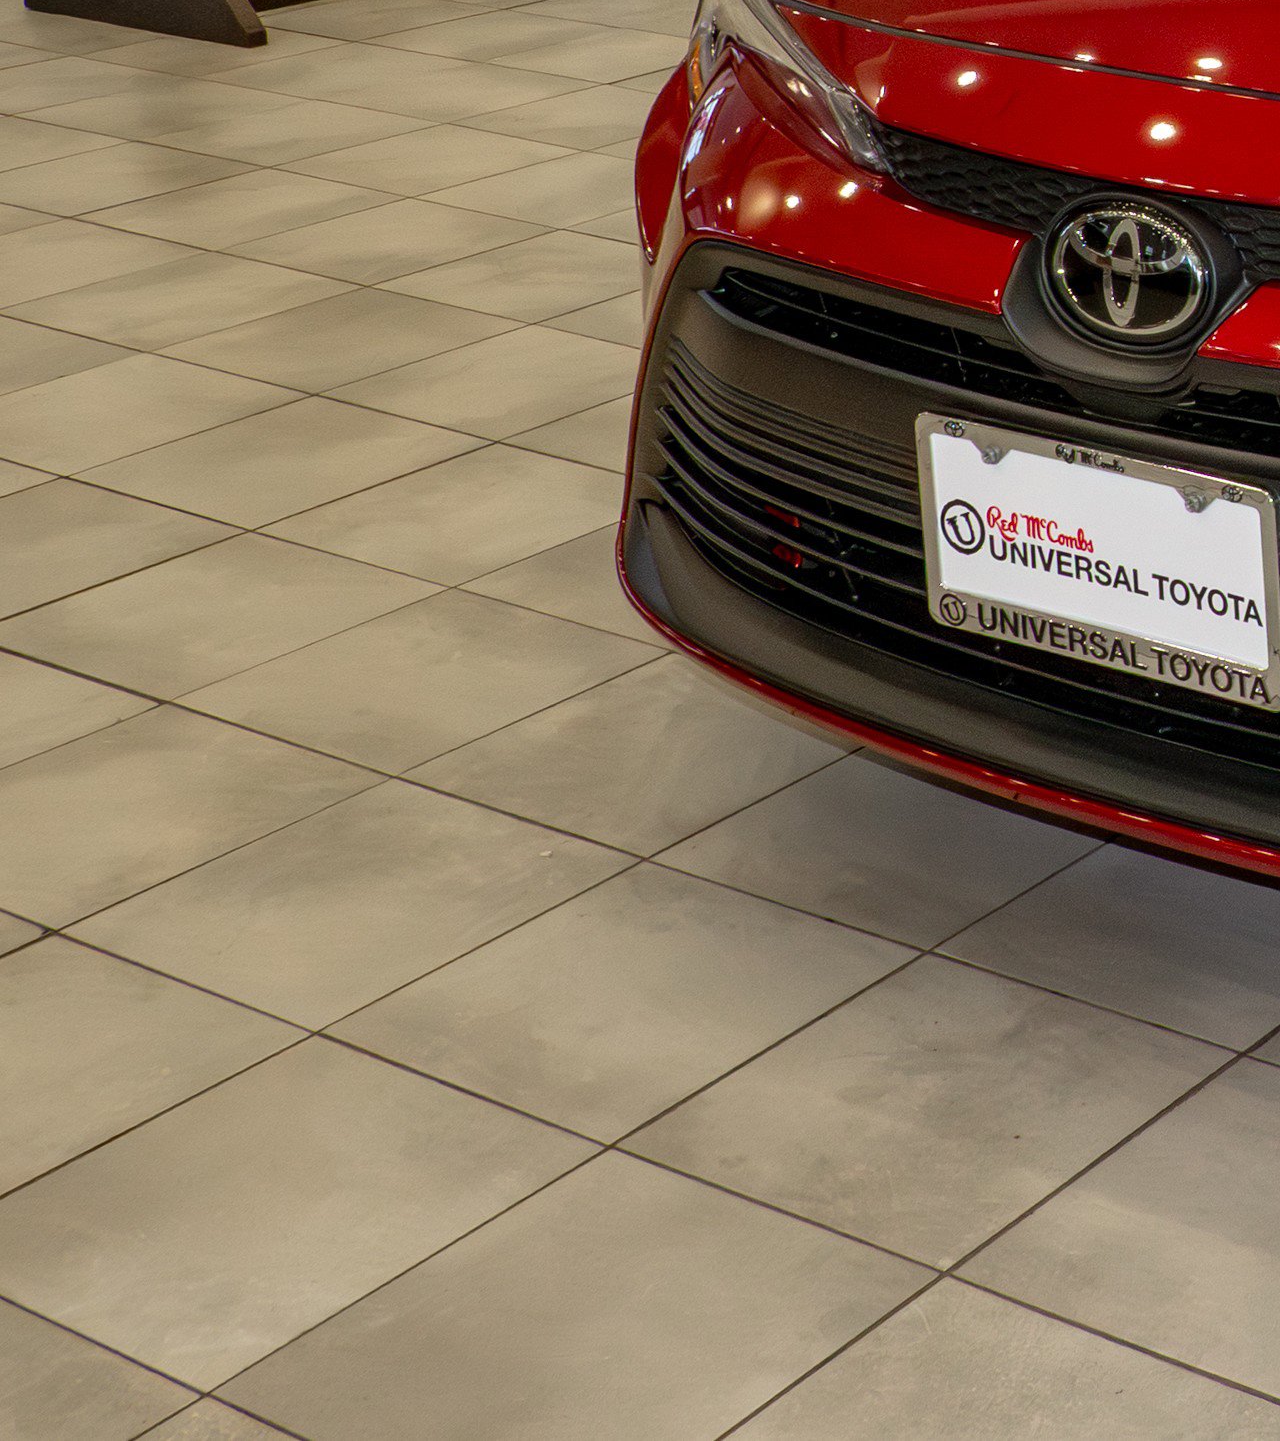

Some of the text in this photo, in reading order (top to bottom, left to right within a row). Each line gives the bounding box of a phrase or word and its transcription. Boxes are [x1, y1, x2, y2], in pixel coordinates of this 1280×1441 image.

[986, 505, 1094, 554] Red McCombs
[989, 534, 1264, 628] UNIVERSAL TOYOTA
[977, 602, 1273, 704] UNIVERSAL TOYOTA
